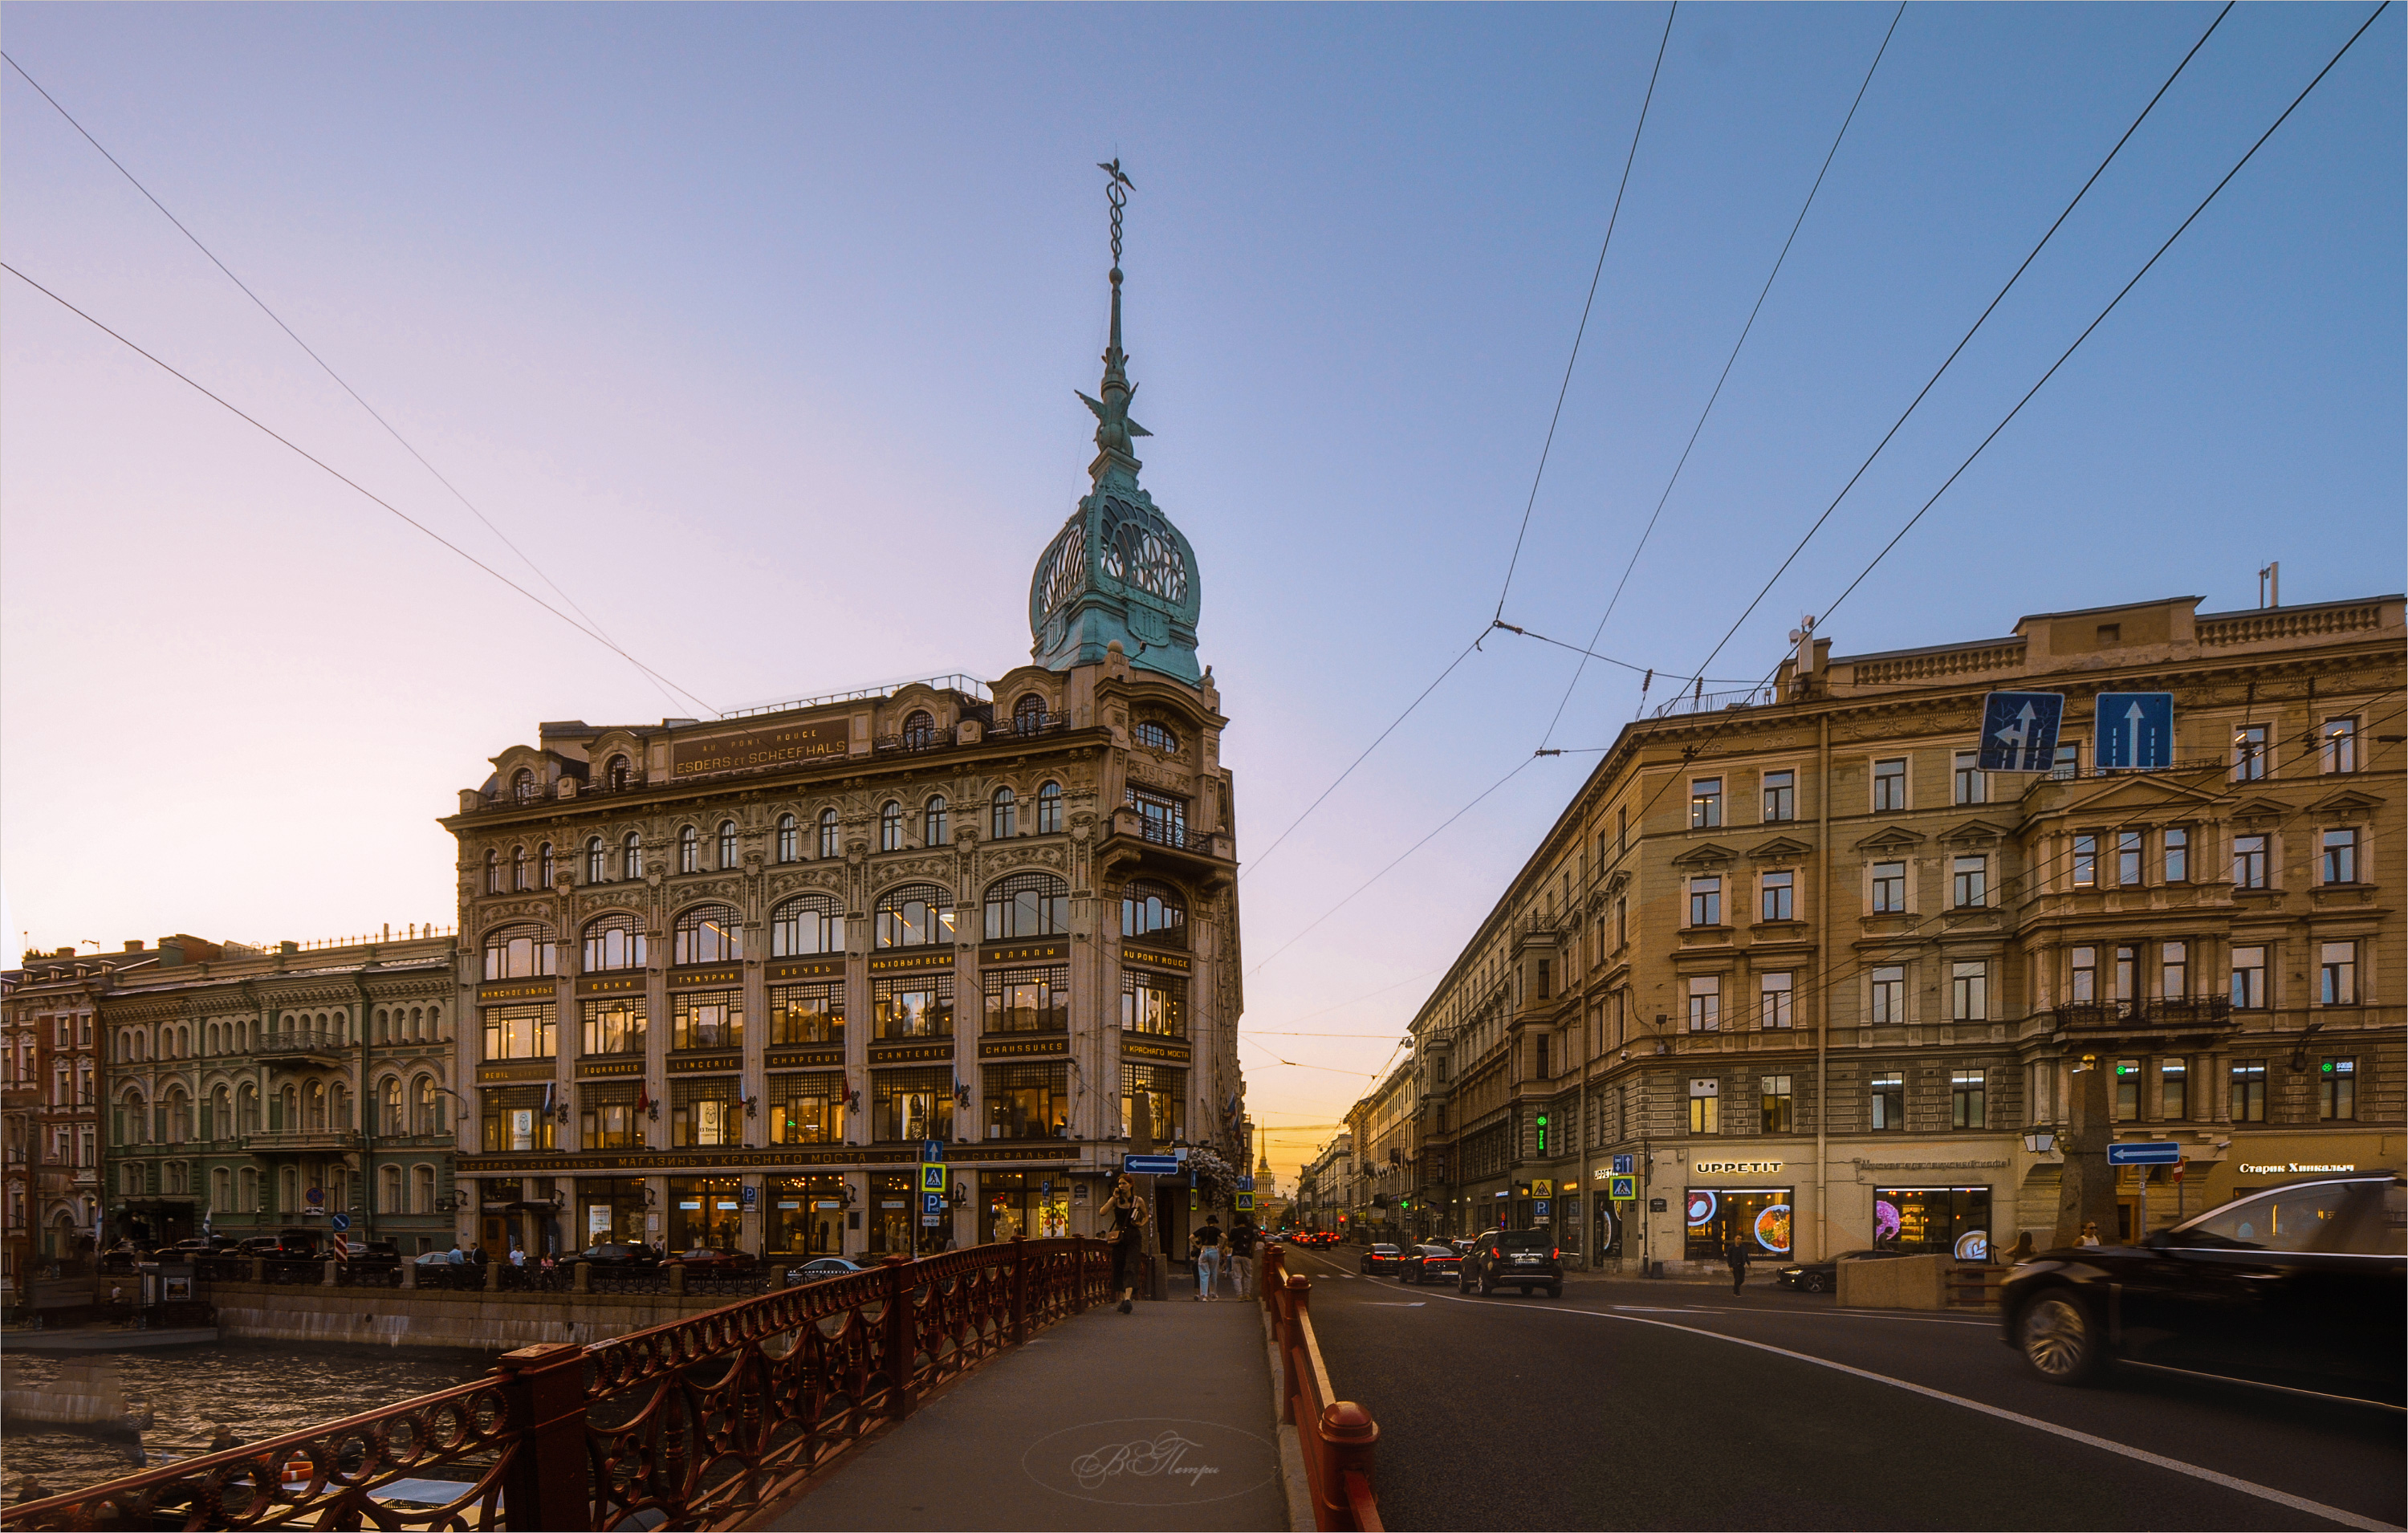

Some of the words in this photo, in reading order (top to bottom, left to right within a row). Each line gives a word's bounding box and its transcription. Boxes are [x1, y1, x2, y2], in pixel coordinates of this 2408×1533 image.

[703, 744, 716, 752] AU
[731, 738, 760, 748] PONT
[776, 730, 817, 742] ROUGE
[677, 757, 731, 774] ESDERS
[734, 758, 745, 766] ET
[748, 741, 846, 764] SCHEEFHALS
[995, 947, 1054, 959] ШЛЯПЫ
[925, 956, 953, 965] ВЕЩИ
[1124, 950, 1134, 958] AU
[1137, 952, 1158, 962] PONT
[1161, 955, 1189, 968] ROUGE
[781, 966, 831, 976] ОБУВЬ
[678, 973, 734, 983] ТУЖУРКИ
[592, 981, 631, 990] ЮБКИ
[482, 989, 522, 998] МУЖСКОЕ
[986, 1043, 1063, 1054] CHAUSSURES
[1129, 1045, 1165, 1056] КРАСНАГО
[1167, 1050, 1190, 1059] МОСТА
[676, 1059, 734, 1069] LINGERIE
[772, 1055, 838, 1064] CHAPEAUX
[584, 1064, 638, 1074] FOURRURES
[485, 1071, 509, 1080] DEUIL
[618, 1157, 697, 1167] МАГАЗИНЪ
[706, 1157, 713, 1165] У
[722, 1154, 802, 1165] КРАСНАГО
[811, 1153, 866, 1164] МОСТА
[972, 1151, 1068, 1161] СХЕФАЛЬСЪ
[462, 1162, 516, 1170] ЭСДЕРСЪ
[530, 1161, 604, 1169] СХЕФАЛЬСЪ
[1696, 1161, 1783, 1174] UPPETIT
[2239, 1163, 2286, 1175] Старик
[2288, 1162, 2355, 1173] Хинкалыч
[746, 1188, 754, 1201] P
[927, 1195, 938, 1212] P
[1537, 1202, 1546, 1214] P
